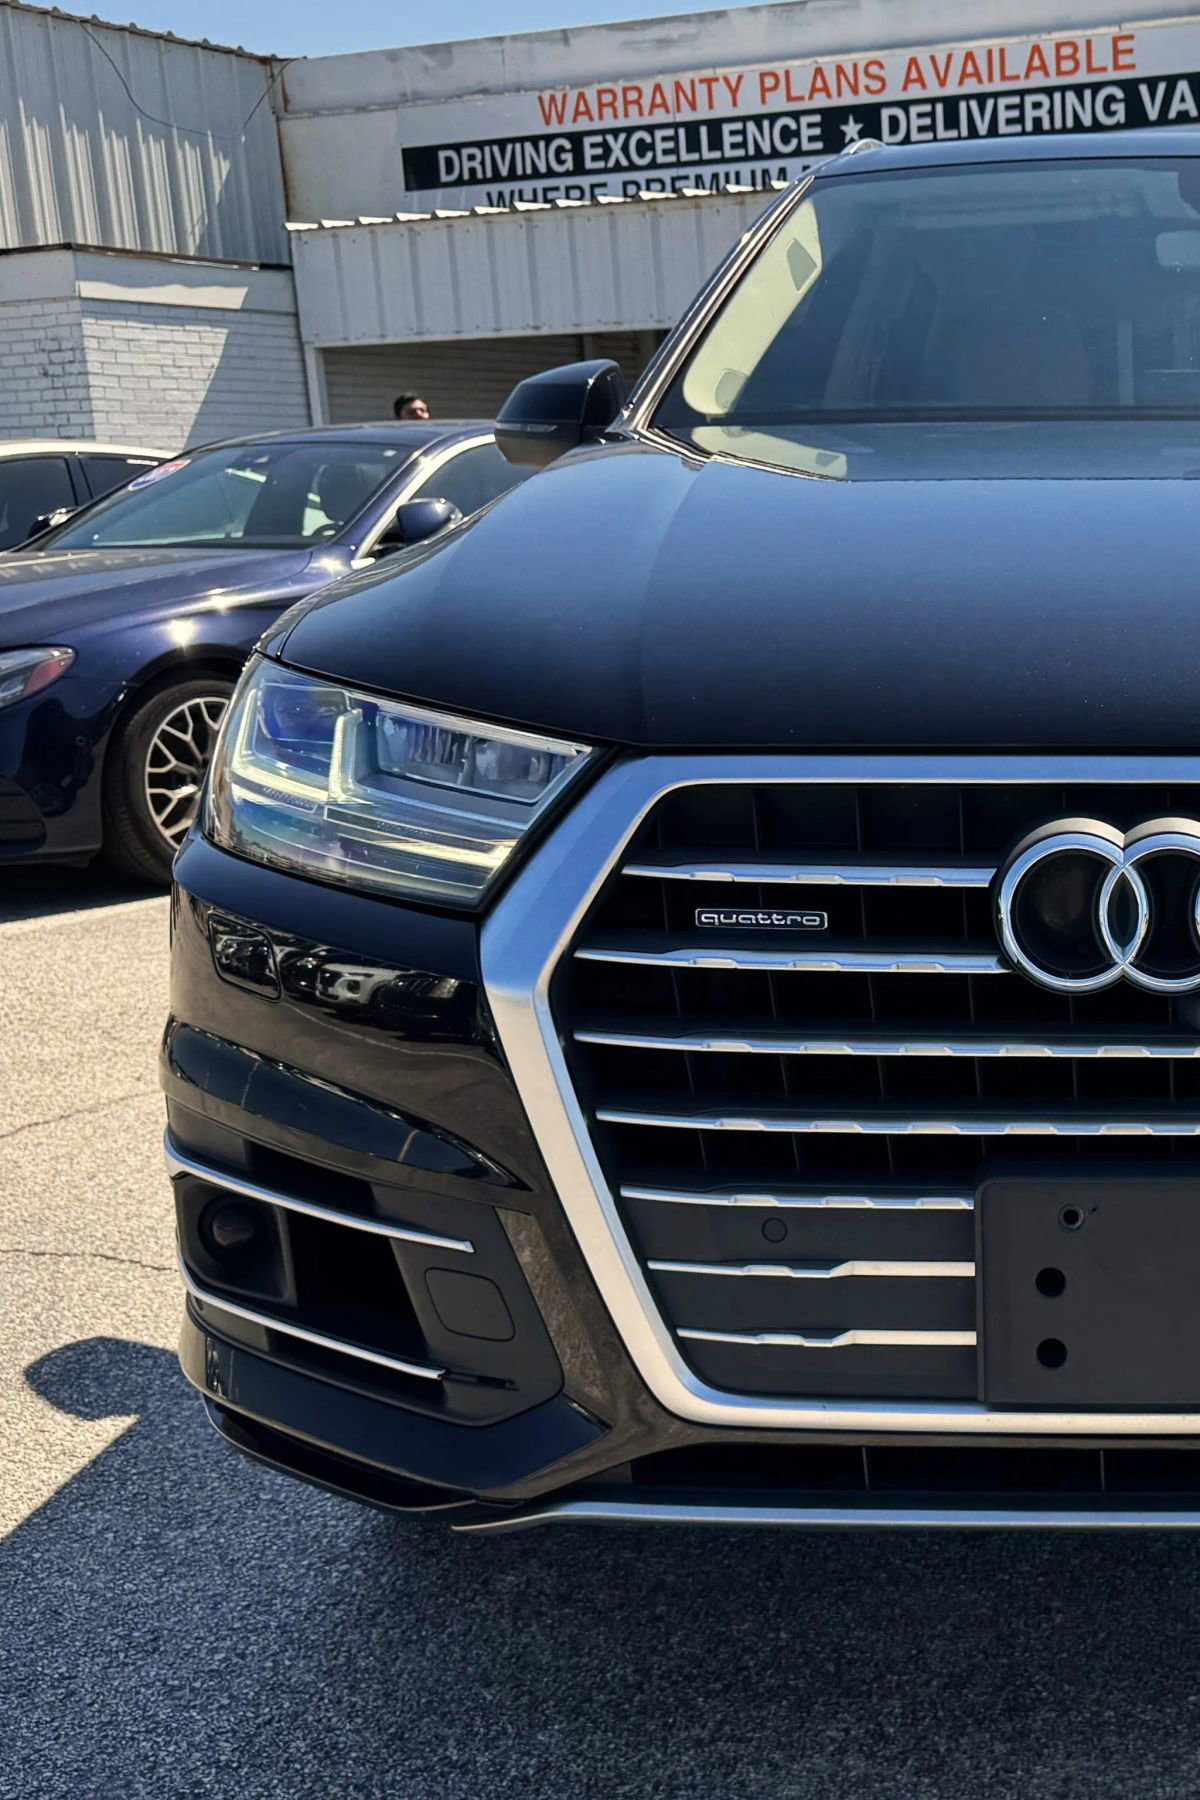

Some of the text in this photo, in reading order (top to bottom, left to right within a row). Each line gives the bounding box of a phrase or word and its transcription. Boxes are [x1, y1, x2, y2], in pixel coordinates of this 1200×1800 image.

[537, 33, 1137, 126] WARRANTY PLANS AVAILABLE
[437, 137, 573, 184] DRIVING
[583, 113, 824, 171] EXCELLENCE
[880, 86, 1126, 145] DELIVERING
[701, 912, 821, 926] quattro
